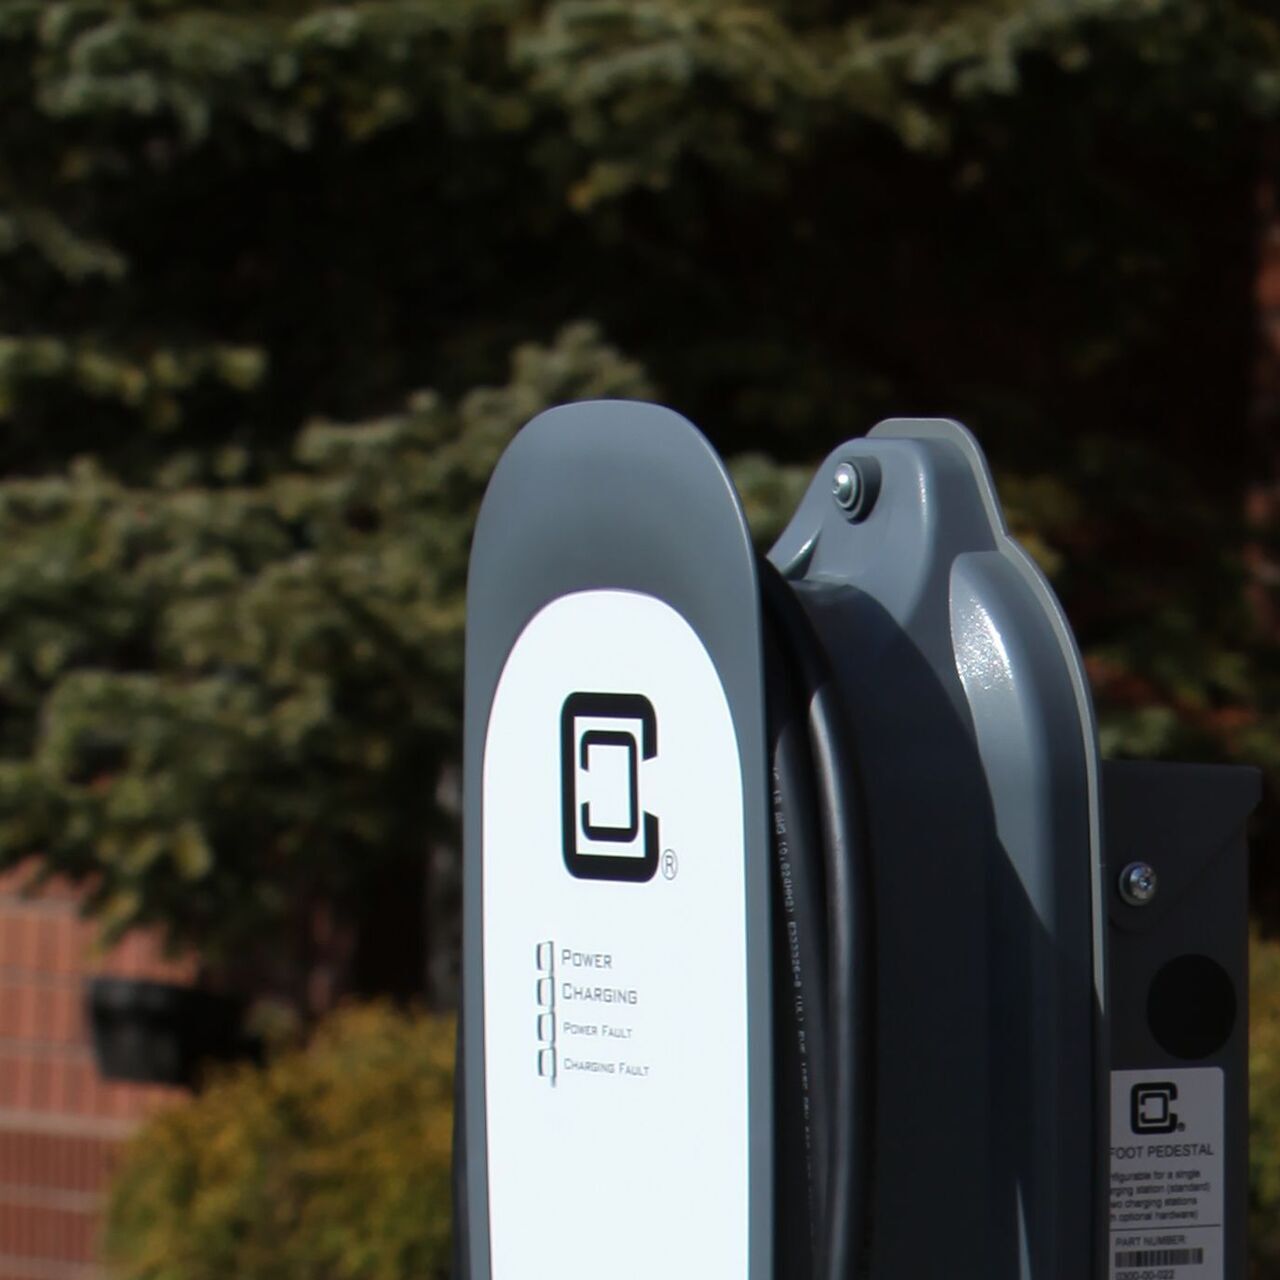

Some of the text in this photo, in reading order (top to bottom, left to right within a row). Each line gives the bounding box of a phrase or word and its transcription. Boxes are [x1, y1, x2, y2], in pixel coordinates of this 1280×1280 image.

[562, 949, 612, 969] POWER
[562, 983, 637, 1005] CHARGING
[563, 1022, 632, 1038] POWER FAULT
[564, 1058, 649, 1076] CHARGING FAULT
[1147, 1144, 1214, 1157] PEDESTAL
[1115, 1236, 1140, 1246] PART
